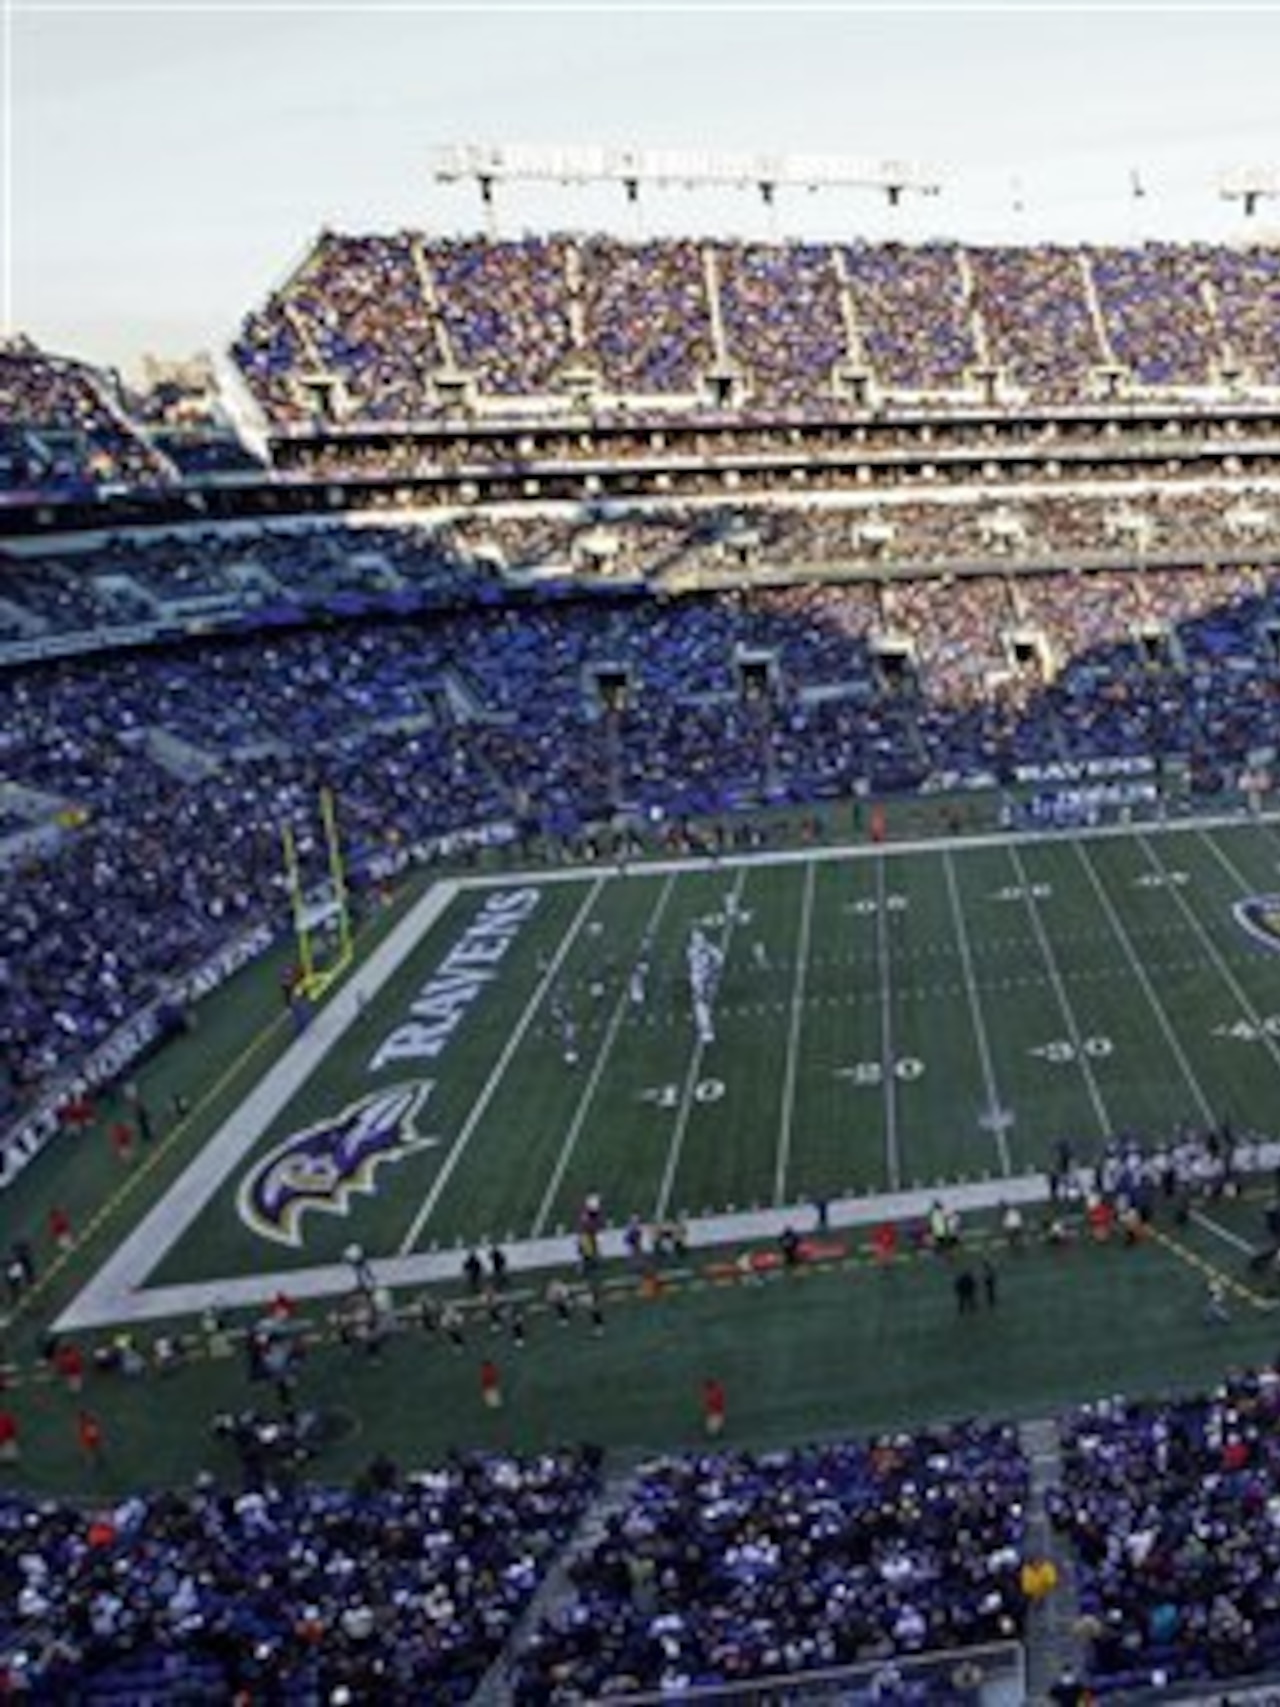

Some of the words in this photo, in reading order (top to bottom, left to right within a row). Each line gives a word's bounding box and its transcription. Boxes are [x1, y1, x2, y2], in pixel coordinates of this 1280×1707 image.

[1012, 756, 1154, 782] RAVENS
[367, 886, 541, 1072] RAVENS
[1044, 1026, 1113, 1063] 30
[853, 1056, 923, 1087] 20
[656, 1077, 726, 1107] 10
